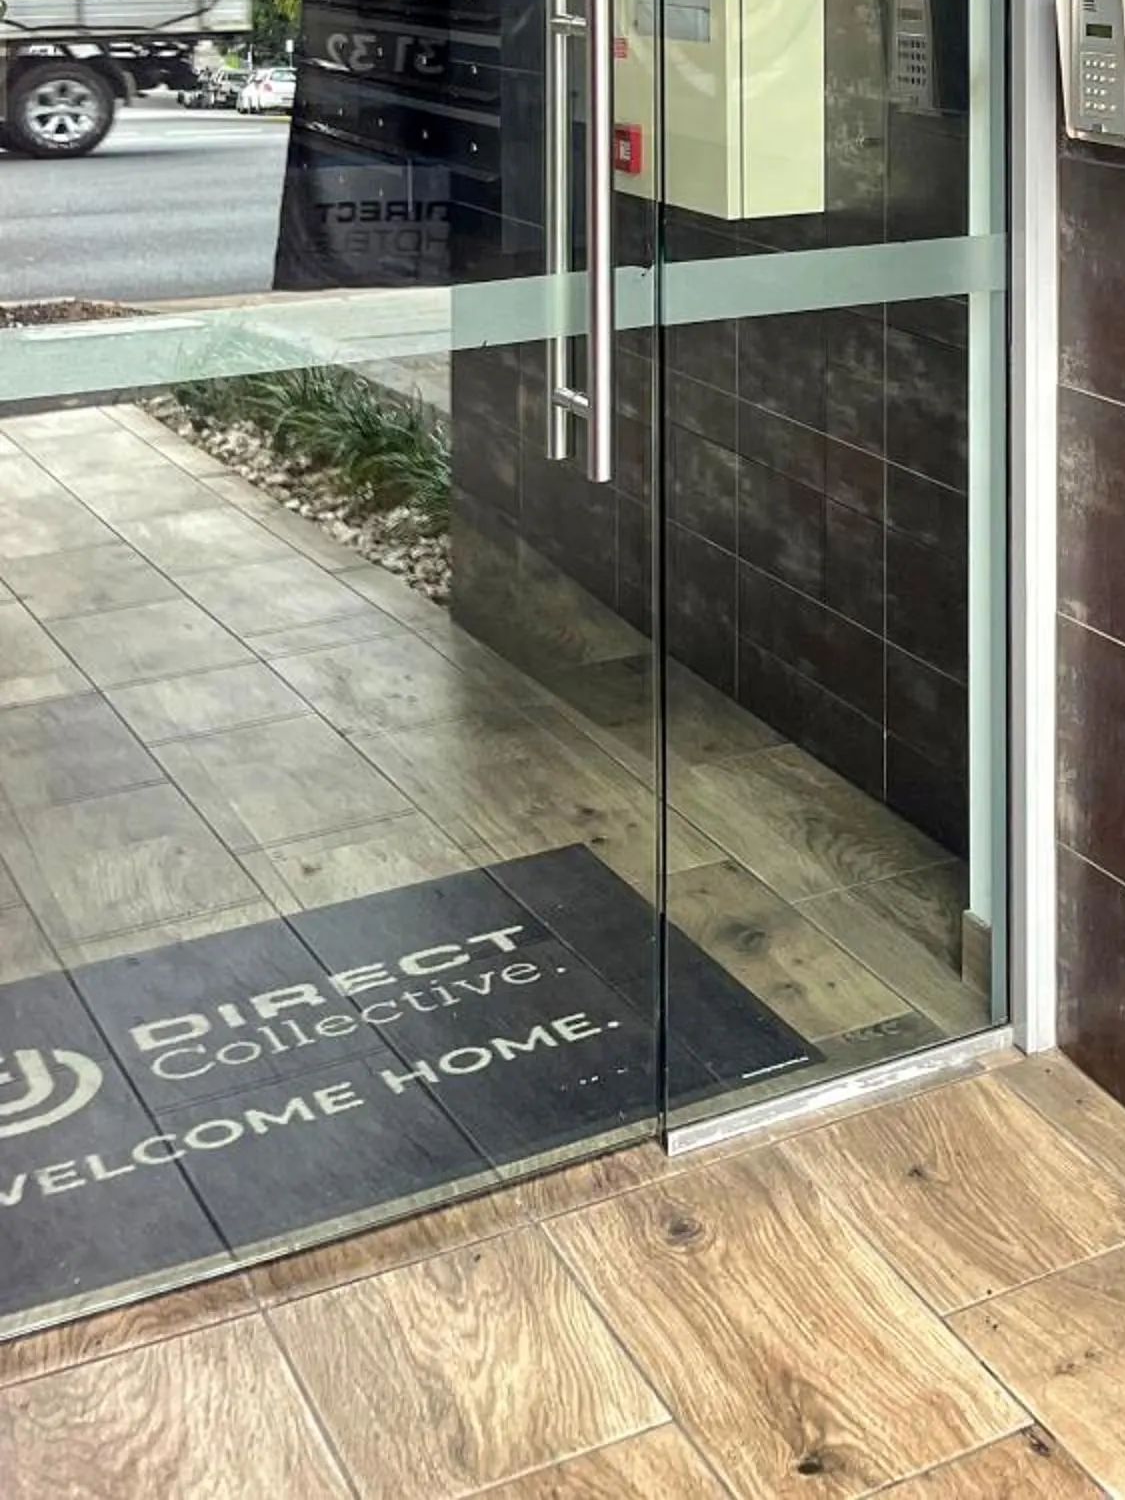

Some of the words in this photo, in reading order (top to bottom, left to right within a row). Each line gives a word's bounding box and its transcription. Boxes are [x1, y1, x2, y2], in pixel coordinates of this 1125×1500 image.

[129, 924, 526, 1051] DIRECT
[152, 960, 568, 1080] Collective.
[380, 1010, 622, 1096] HOME.
